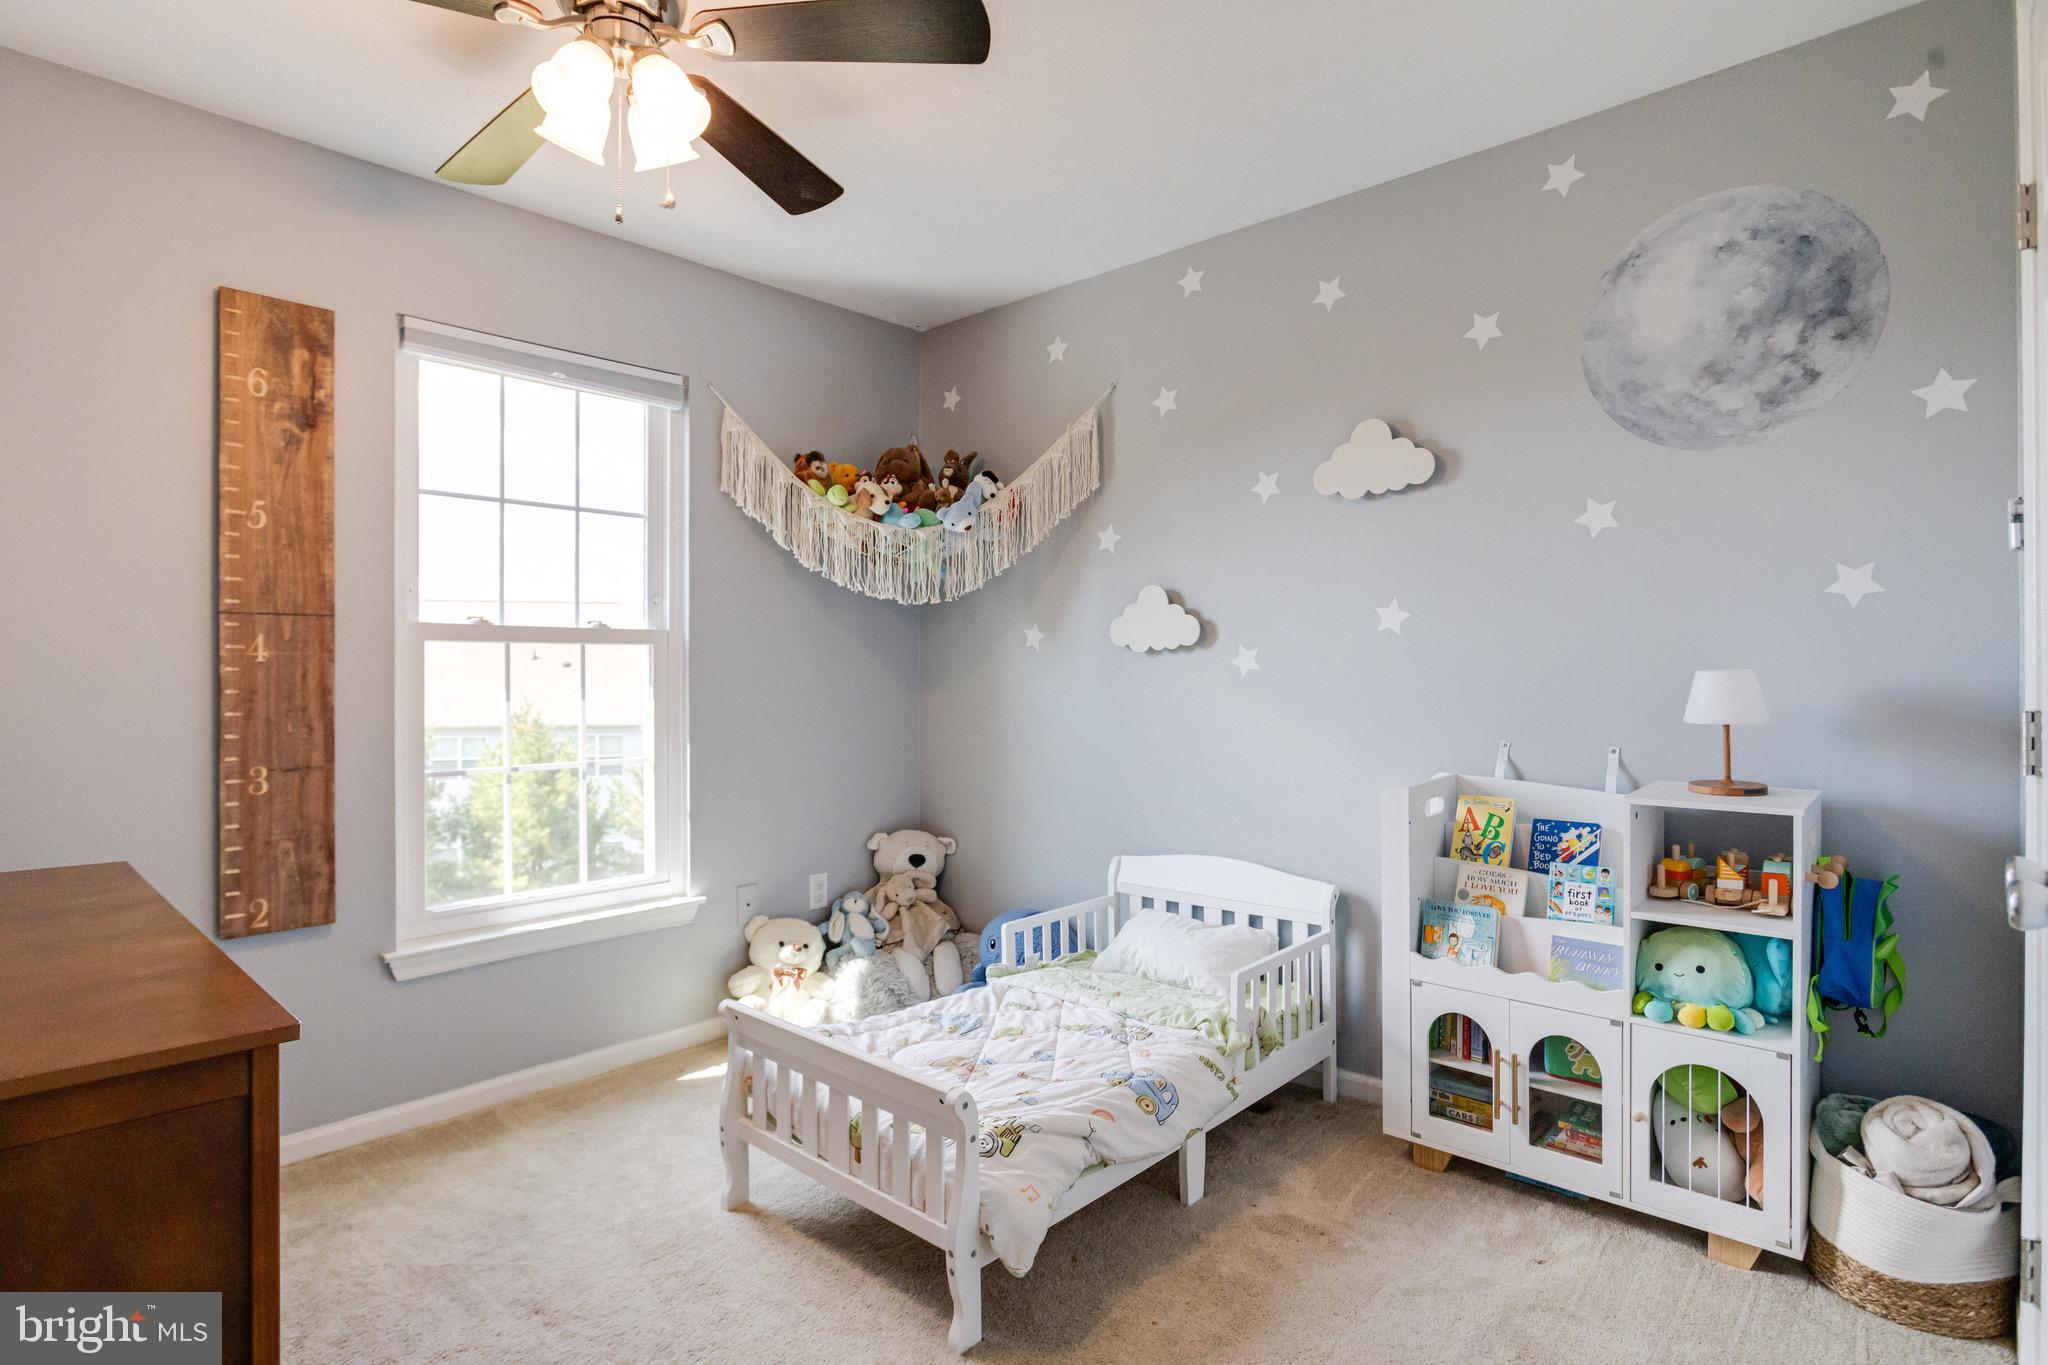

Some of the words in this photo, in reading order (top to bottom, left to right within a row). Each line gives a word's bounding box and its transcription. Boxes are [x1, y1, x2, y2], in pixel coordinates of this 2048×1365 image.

[247, 367, 268, 397] 6
[246, 500, 267, 529] 5
[246, 634, 269, 663] 4
[248, 766, 269, 796] 3
[1536, 822, 1551, 832] THE
[1534, 832, 1559, 843] GOING
[1533, 850, 1551, 861] BED
[1533, 860, 1550, 870] BOO
[1479, 869, 1506, 878] GUESS
[1467, 874, 1487, 882] HOW
[1490, 878, 1517, 887] MUCH
[1471, 882, 1496, 892] LOVE
[1498, 886, 1519, 895] YOU
[1567, 888, 1593, 900] first
[1569, 899, 1590, 907] book
[249, 899, 269, 929] 2
[1430, 904, 1446, 912] LOVE
[1462, 910, 1491, 919] FOREVER
[1448, 1109, 1474, 1122] CARS
